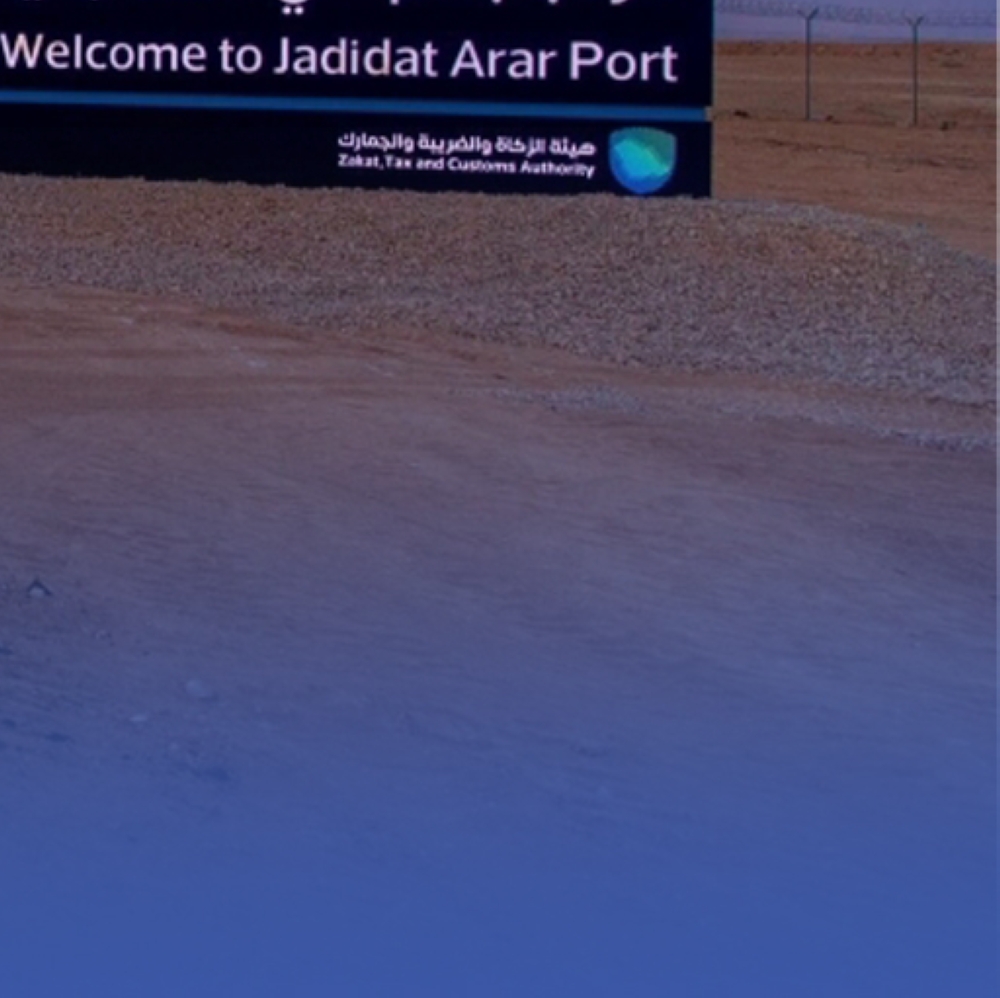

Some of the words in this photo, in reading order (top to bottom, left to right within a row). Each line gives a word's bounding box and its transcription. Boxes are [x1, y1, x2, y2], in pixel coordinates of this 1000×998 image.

[0, 33, 207, 72] Welcome
[218, 38, 263, 74] to
[274, 37, 438, 78] Jadidat
[450, 39, 557, 79] Arar
[570, 41, 678, 82] Port
[338, 131, 414, 153] والجمارك
[418, 133, 492, 156] والضريبة
[495, 135, 546, 158] الزكاة
[416, 157, 445, 170] and
[447, 156, 516, 173] Customs
[520, 160, 596, 179] Authority
